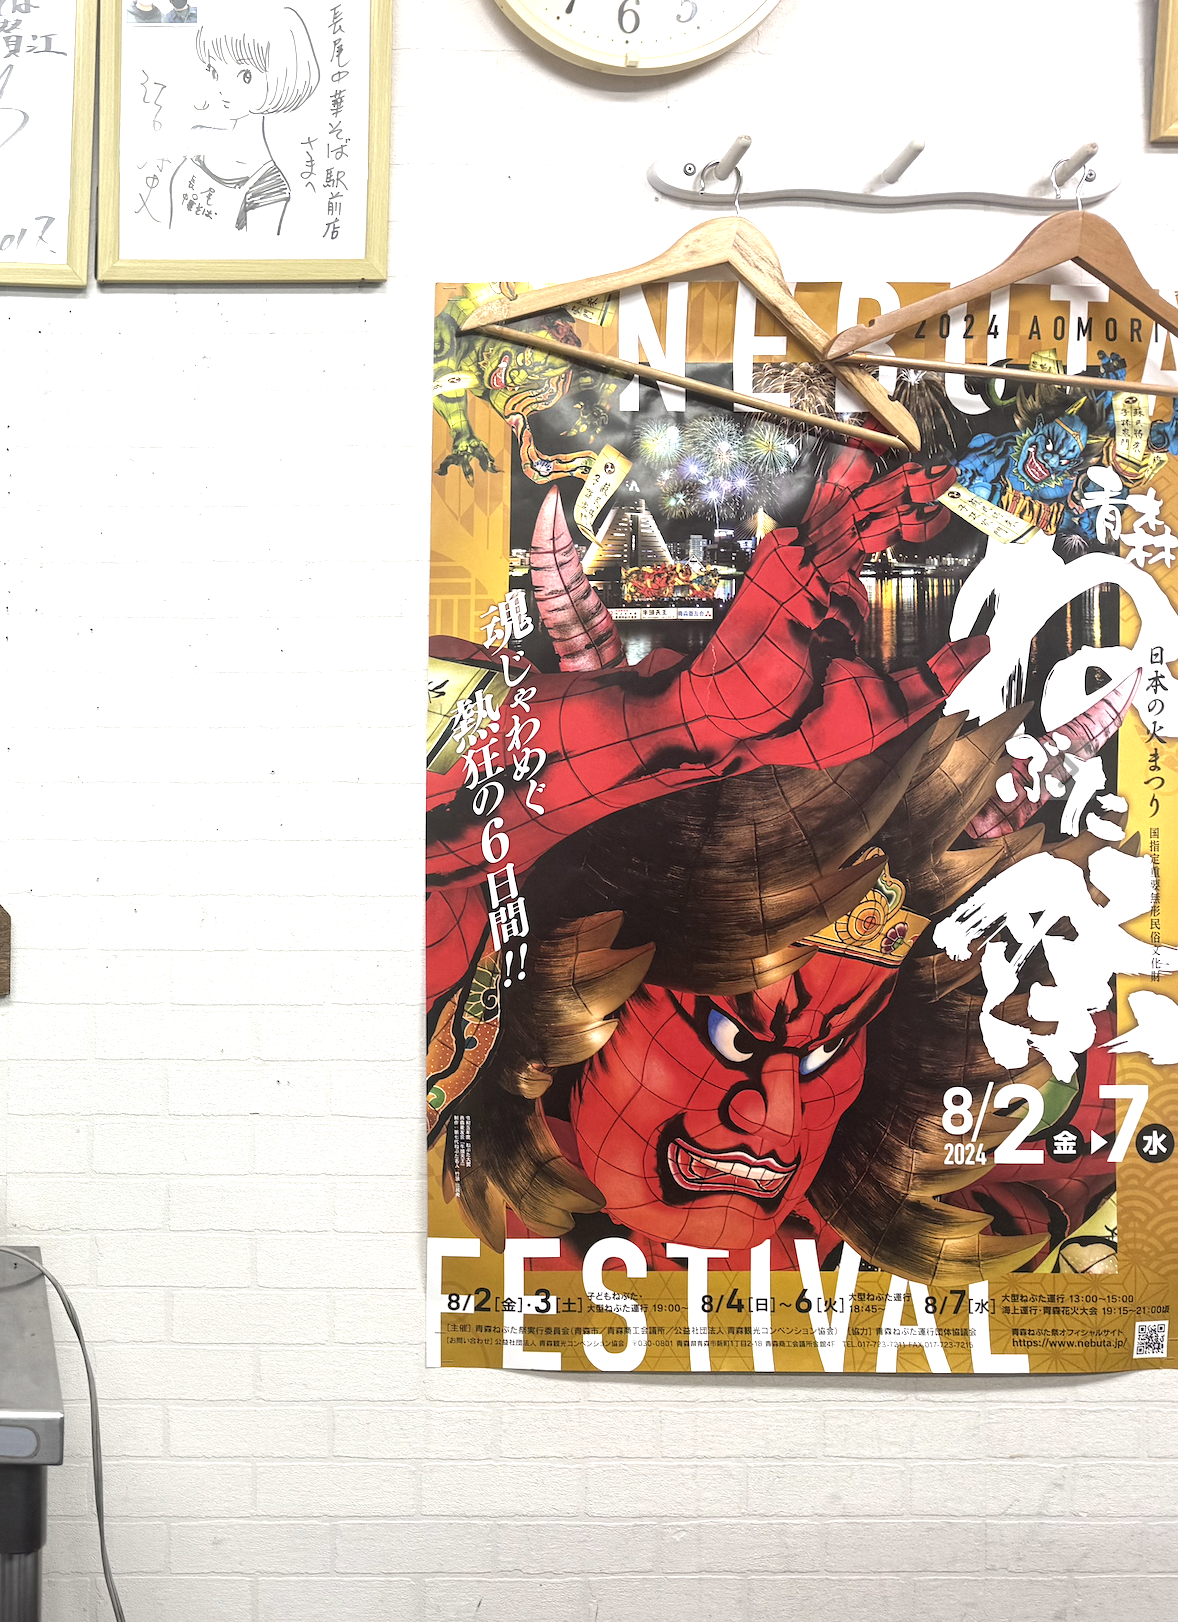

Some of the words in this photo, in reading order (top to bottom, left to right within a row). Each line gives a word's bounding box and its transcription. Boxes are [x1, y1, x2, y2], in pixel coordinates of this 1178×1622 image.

[618, 0, 640, 33] 6
[914, 314, 1000, 340] 2024
[1143, 646, 1169, 819] 日本の火まつり
[942, 1081, 1045, 1165] 8/2
[1052, 1130, 1078, 1155] 金
[1098, 1084, 1150, 1163] 7
[1142, 1130, 1169, 1156] 水
[943, 1142, 988, 1166] 2024
[1001, 1293, 1066, 1304] 大型ねぶた運行
[1011, 1337, 1128, 1349] https://www.nebuta.jp/
